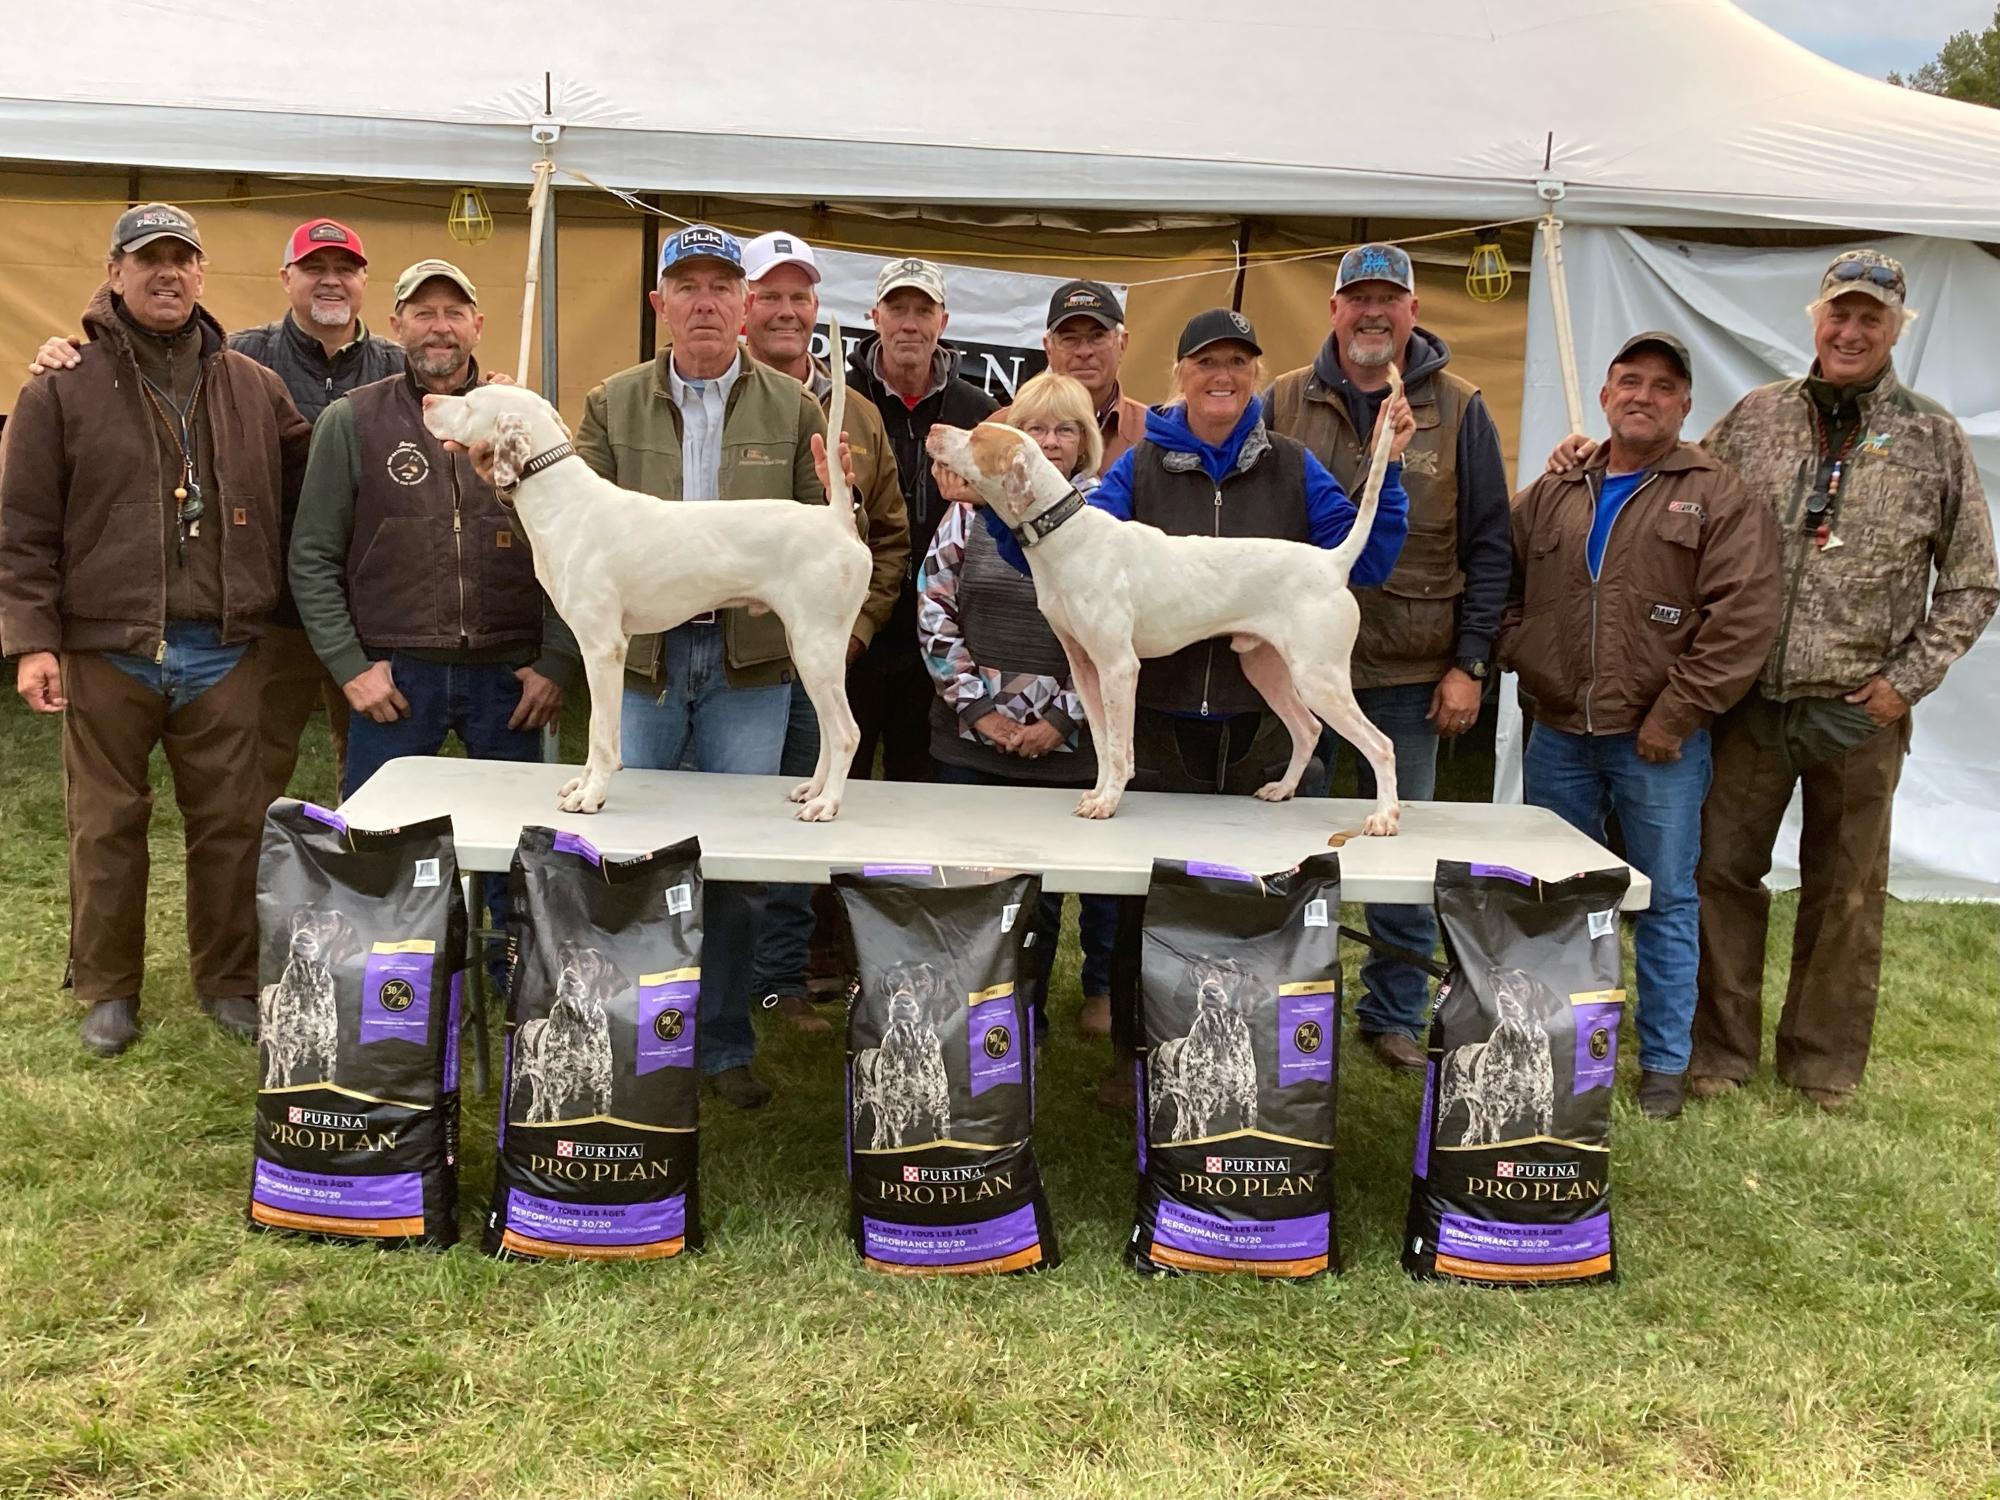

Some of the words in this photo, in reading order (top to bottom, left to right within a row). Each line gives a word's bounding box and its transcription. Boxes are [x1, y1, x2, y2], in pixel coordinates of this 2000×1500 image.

[303, 1111, 364, 1129] PURINA
[270, 1121, 315, 1149] PRO
[319, 1131, 398, 1152] PLAN
[574, 1144, 641, 1159] PURINA
[530, 1154, 587, 1181] PRO
[592, 1158, 673, 1182] PLAN
[920, 1167, 983, 1181] PURINA
[1224, 1159, 1287, 1173] PURINA
[1515, 1164, 1578, 1178] PURINA
[880, 1180, 935, 1205] PRO
[940, 1171, 1015, 1205] PLAN
[1179, 1173, 1238, 1197] PRO
[1243, 1174, 1316, 1198] PLAN
[1466, 1176, 1527, 1201] PRO
[1534, 1179, 1600, 1202] PLAN
[511, 1206, 579, 1227] PERFORMANCE
[581, 1219, 612, 1229] 30/20
[868, 1232, 935, 1249] PERFORMANCE
[936, 1239, 966, 1249] 30/20
[1161, 1217, 1231, 1242] PERFORMANCE
[1233, 1235, 1262, 1244] 30/20
[1445, 1227, 1518, 1247] PERFORMANCE
[1520, 1239, 1550, 1248] 30/20
